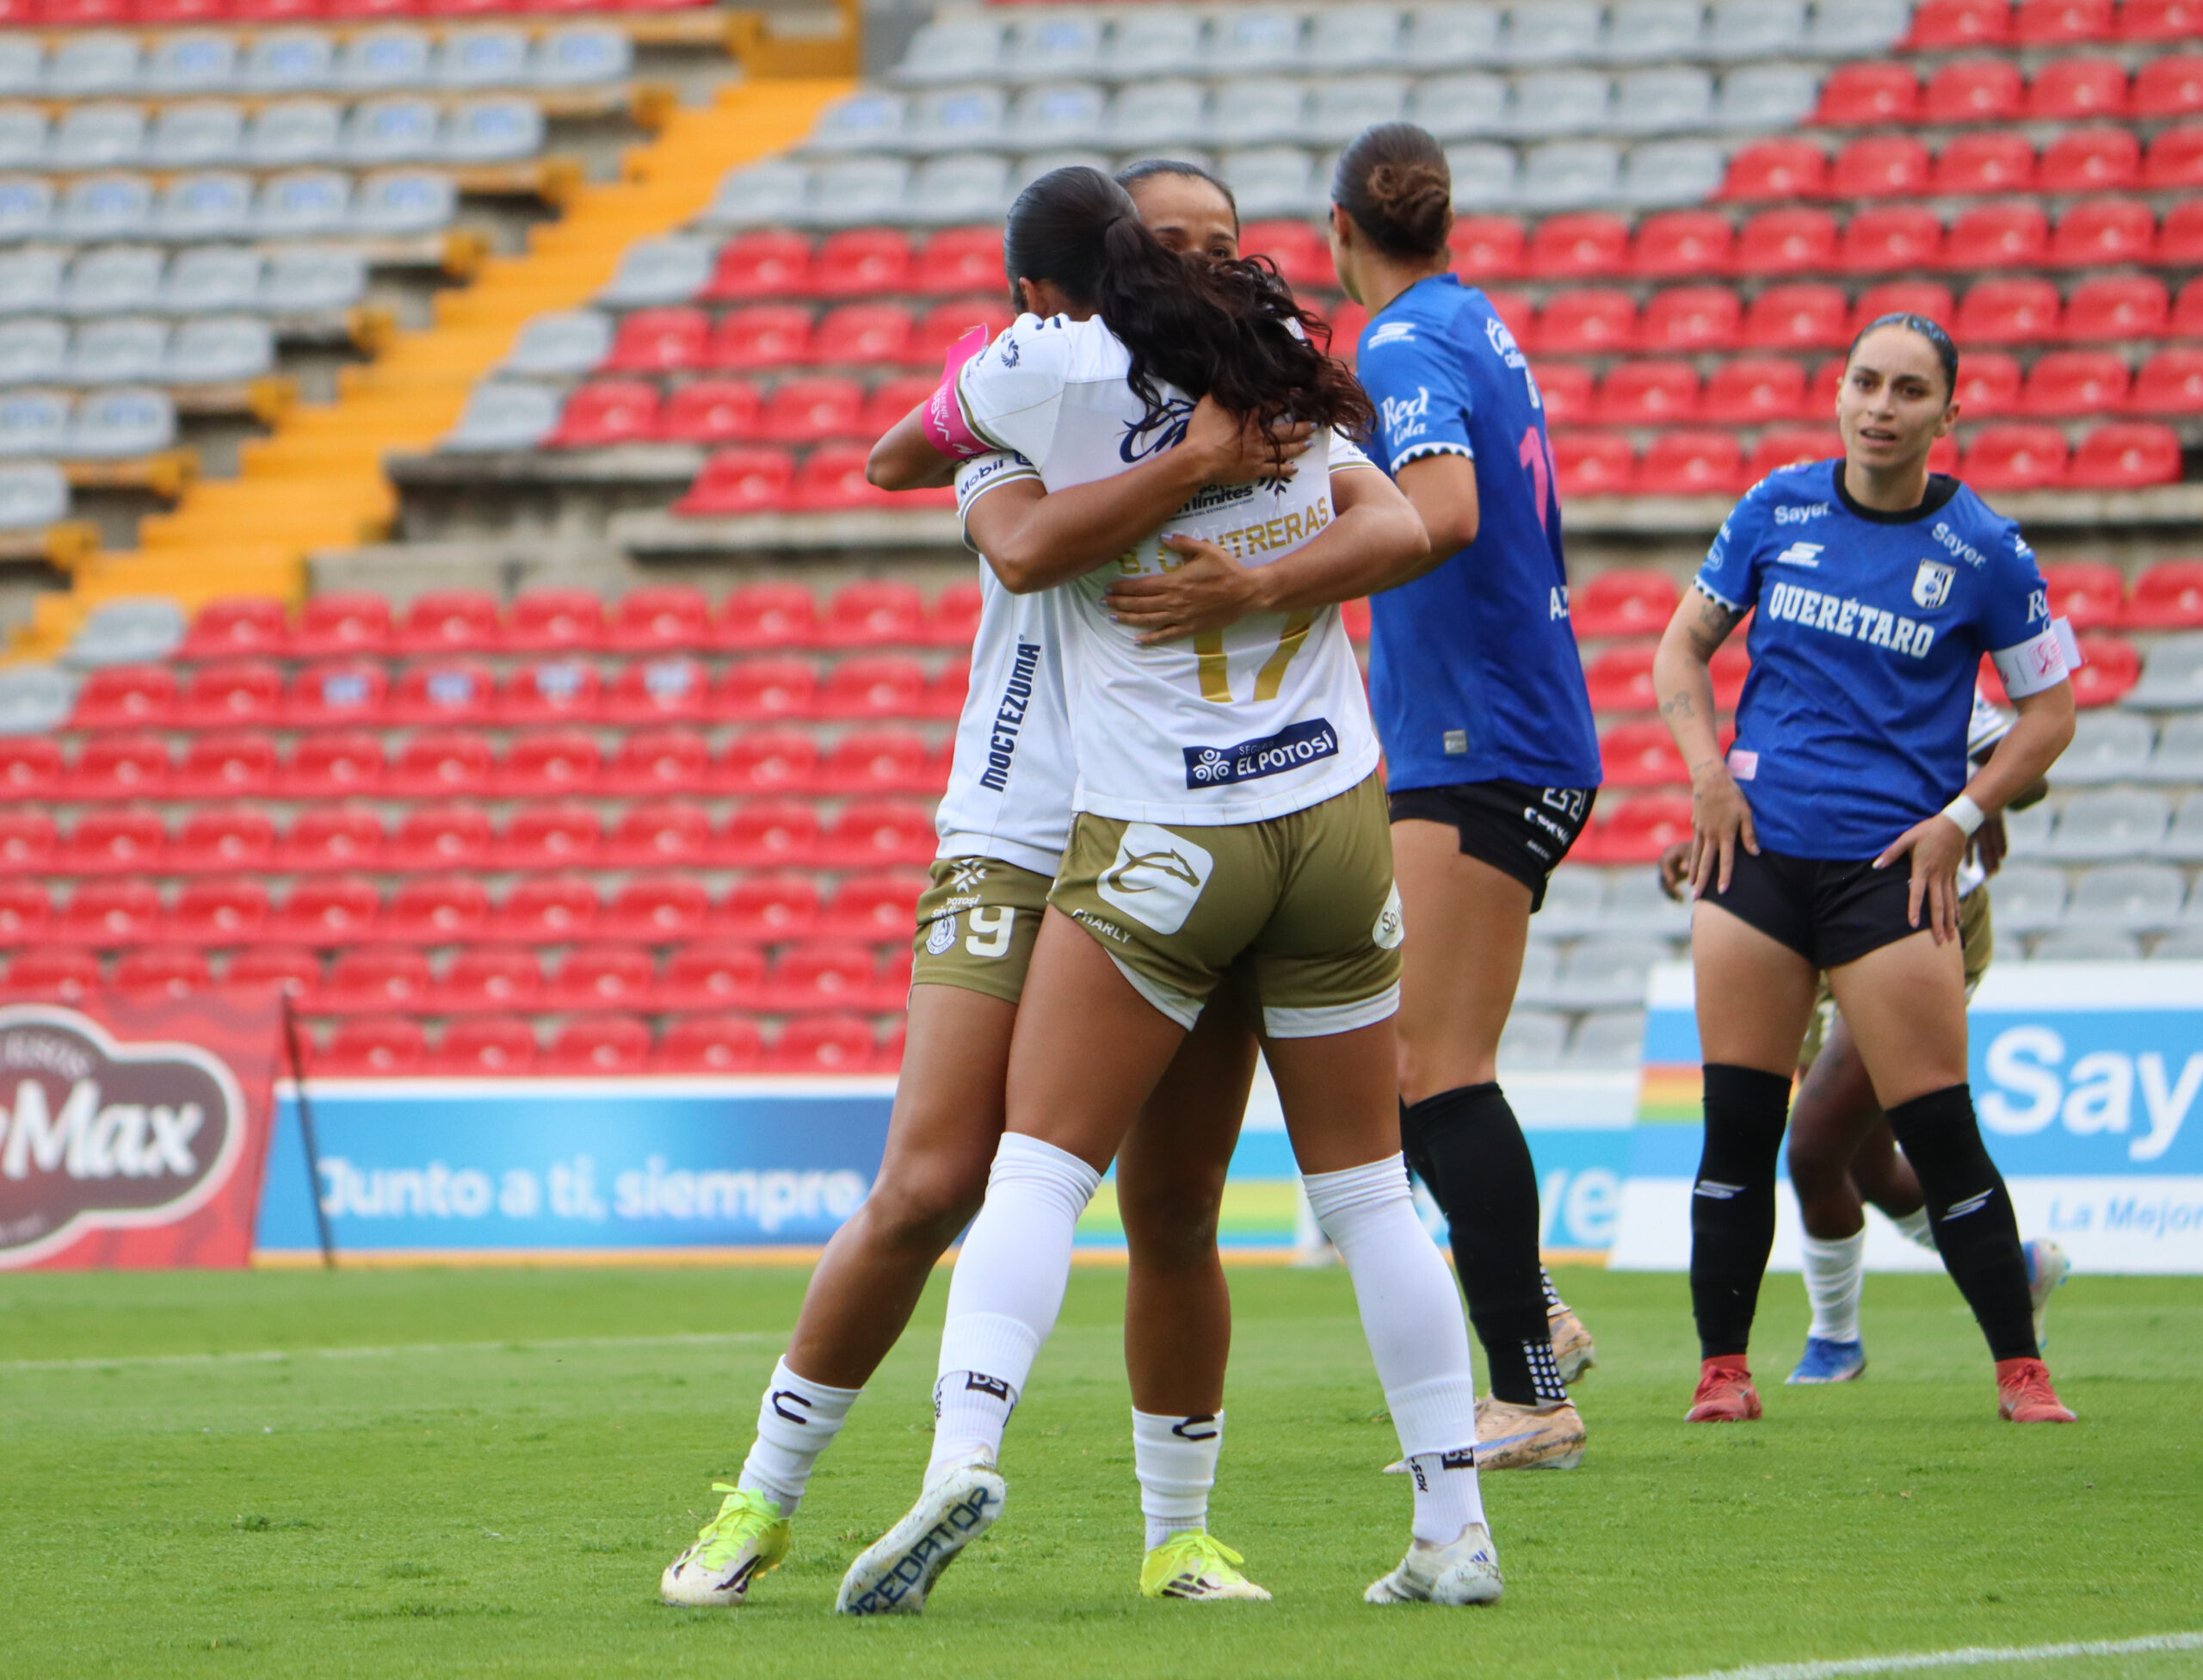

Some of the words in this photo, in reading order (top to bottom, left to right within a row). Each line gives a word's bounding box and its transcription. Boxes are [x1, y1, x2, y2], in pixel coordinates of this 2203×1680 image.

[1381, 386, 1429, 434] Red
[960, 457, 1004, 497] Mobil
[1932, 521, 1987, 570] Sayer
[1768, 581, 1935, 659] QUERÉTARO
[979, 643, 1041, 793] MOCTEZUMA
[1237, 757, 1257, 776] EL
[1258, 730, 1335, 771] POTOSÍ
[966, 905, 1015, 958] 9
[317, 1155, 492, 1219] Junto
[497, 1168, 540, 1219] a
[613, 1152, 869, 1233] siempre
[2047, 1195, 2092, 1232] La
